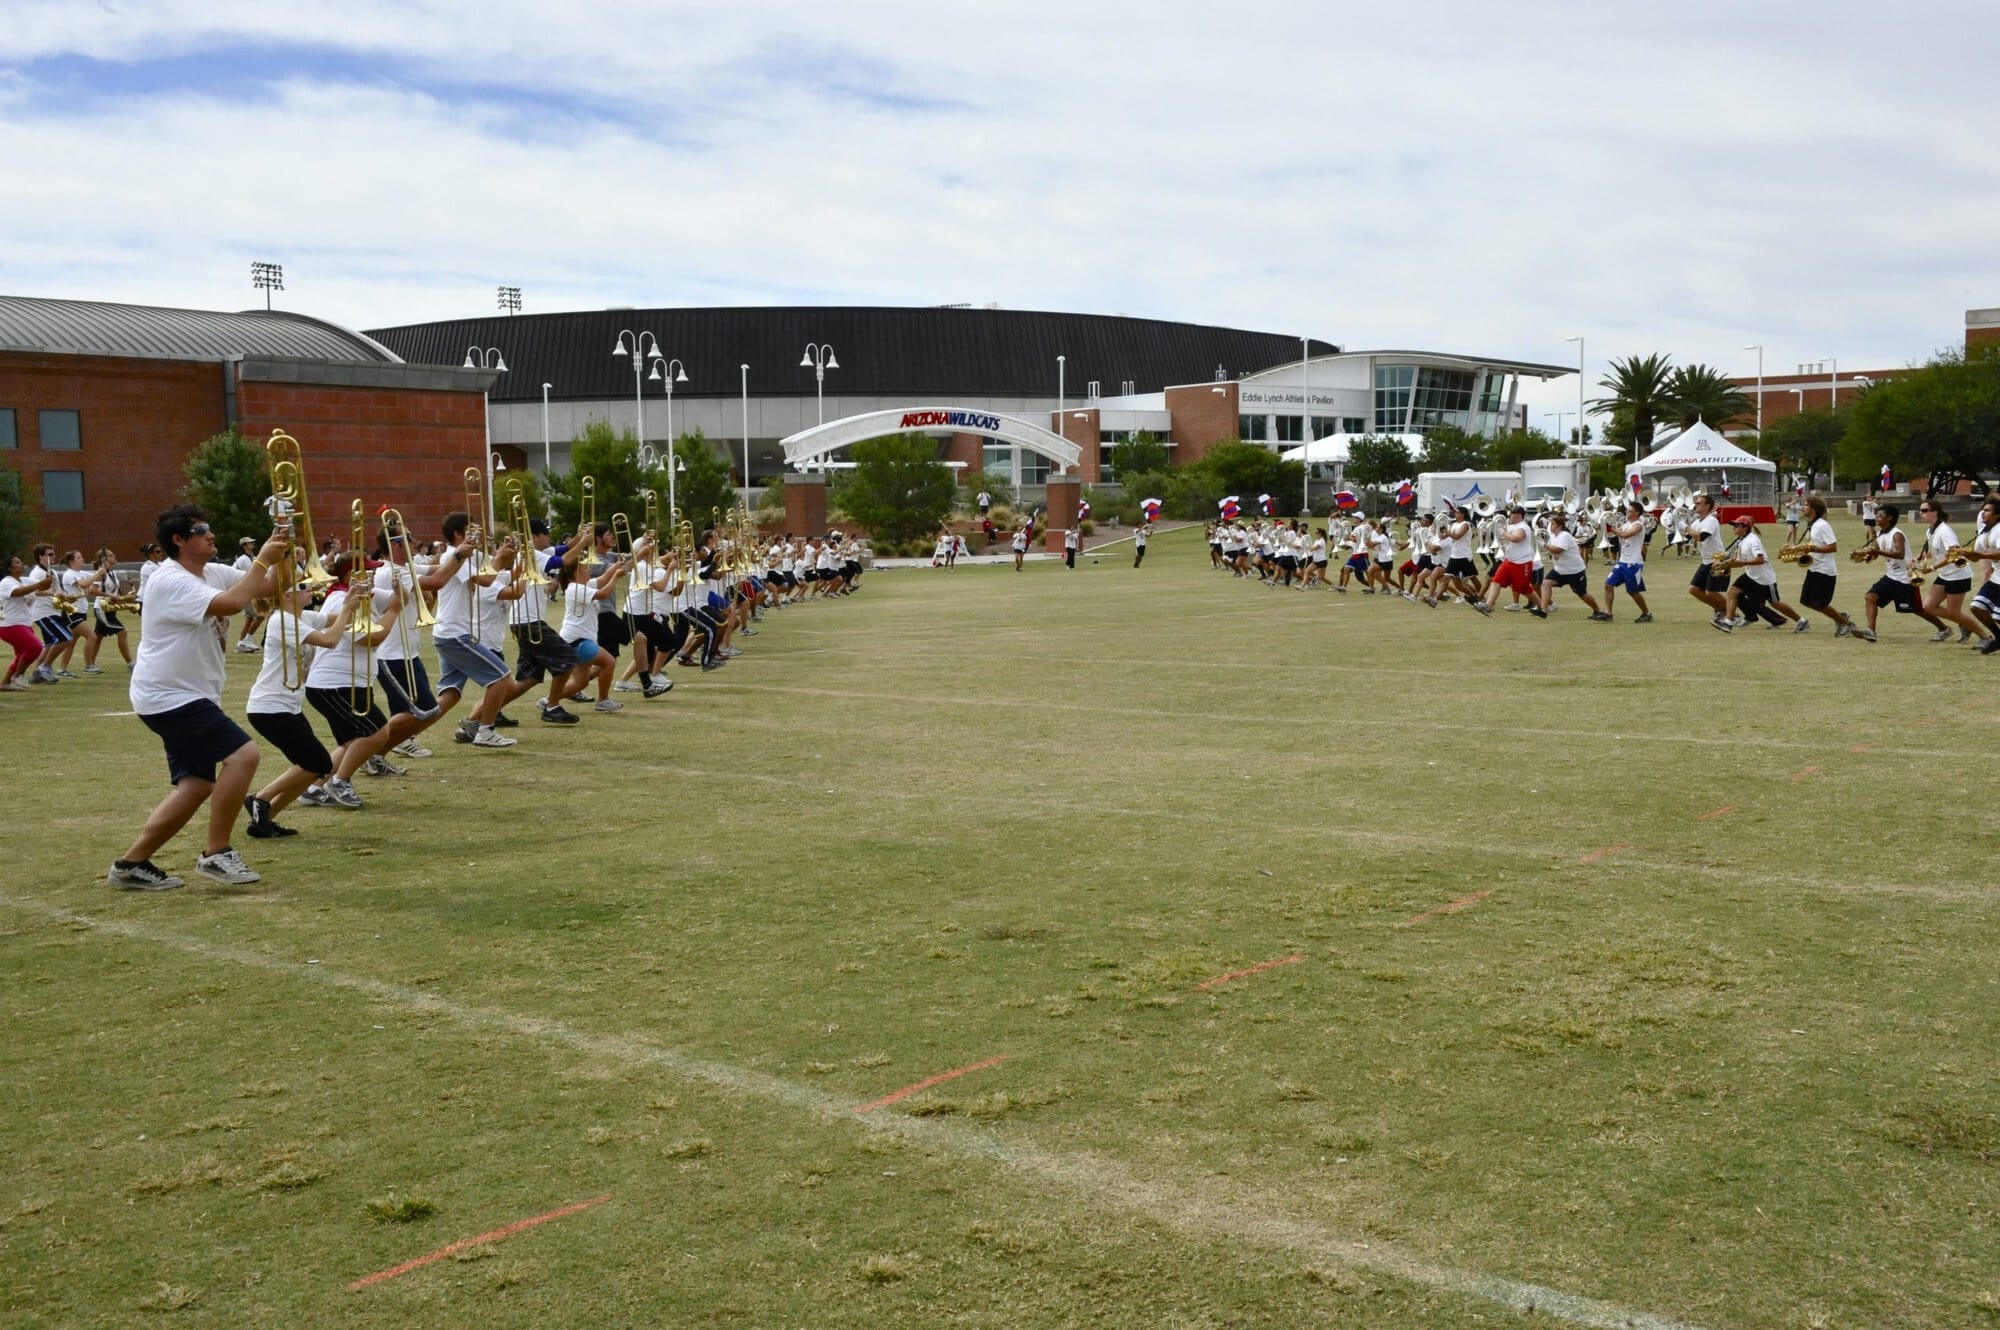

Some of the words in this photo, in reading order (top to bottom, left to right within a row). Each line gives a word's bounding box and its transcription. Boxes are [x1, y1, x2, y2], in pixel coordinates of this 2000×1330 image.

[1242, 392, 1262, 402] Eddie
[1264, 393, 1283, 404] Lynch
[1285, 394, 1311, 404] Athletis
[1312, 395, 1334, 405] Pavilion
[1696, 439, 1711, 451] A
[1654, 457, 1698, 466] ARIZONA
[1699, 456, 1756, 464] ATHLETICS
